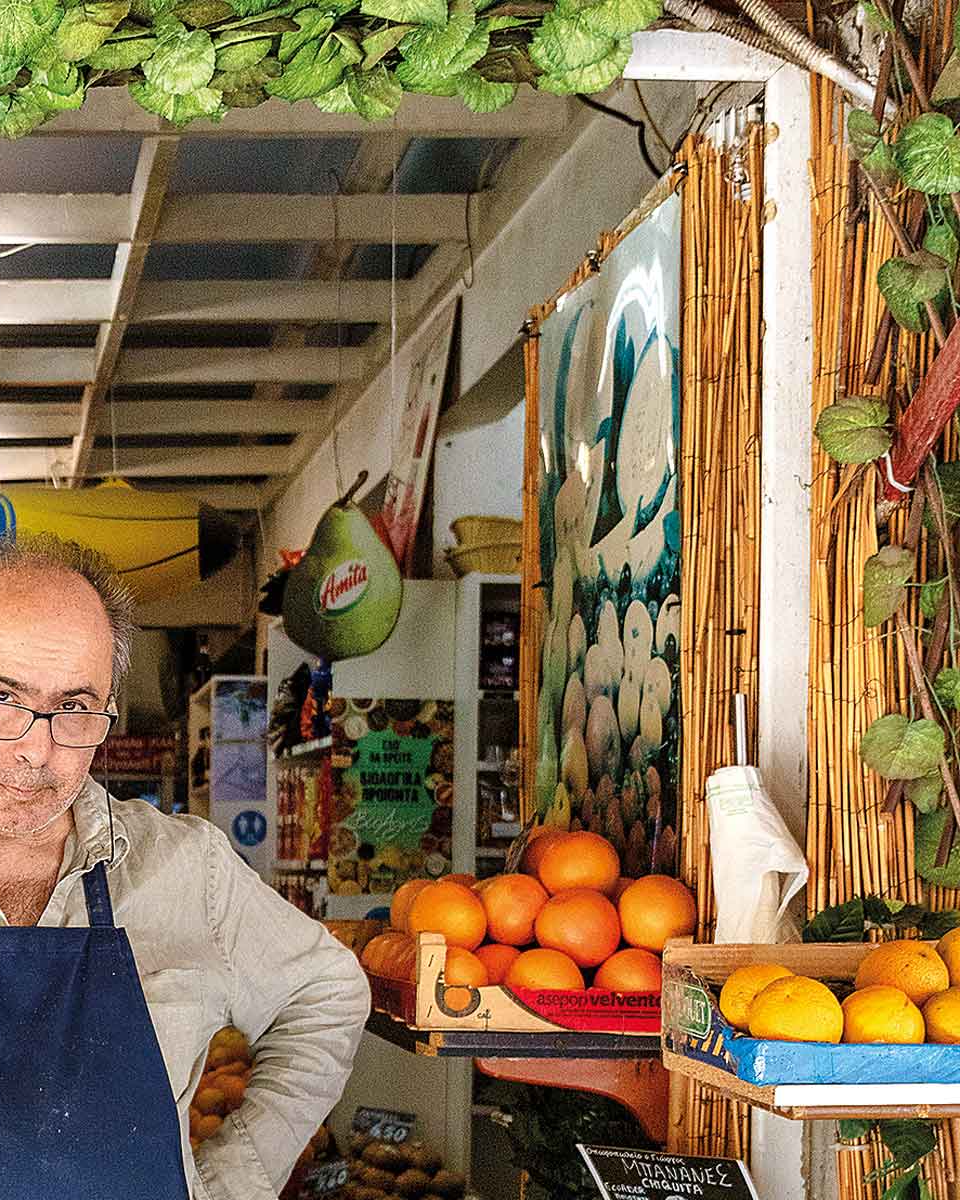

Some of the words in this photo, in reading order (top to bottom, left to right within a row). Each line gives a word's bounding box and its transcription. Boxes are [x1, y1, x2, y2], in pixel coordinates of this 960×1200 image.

[321, 562, 367, 608] Amita
[621, 1157, 733, 1188] ΜΠΑΝΑΝΕΣ
[642, 1178, 704, 1196] CHIQUITA
